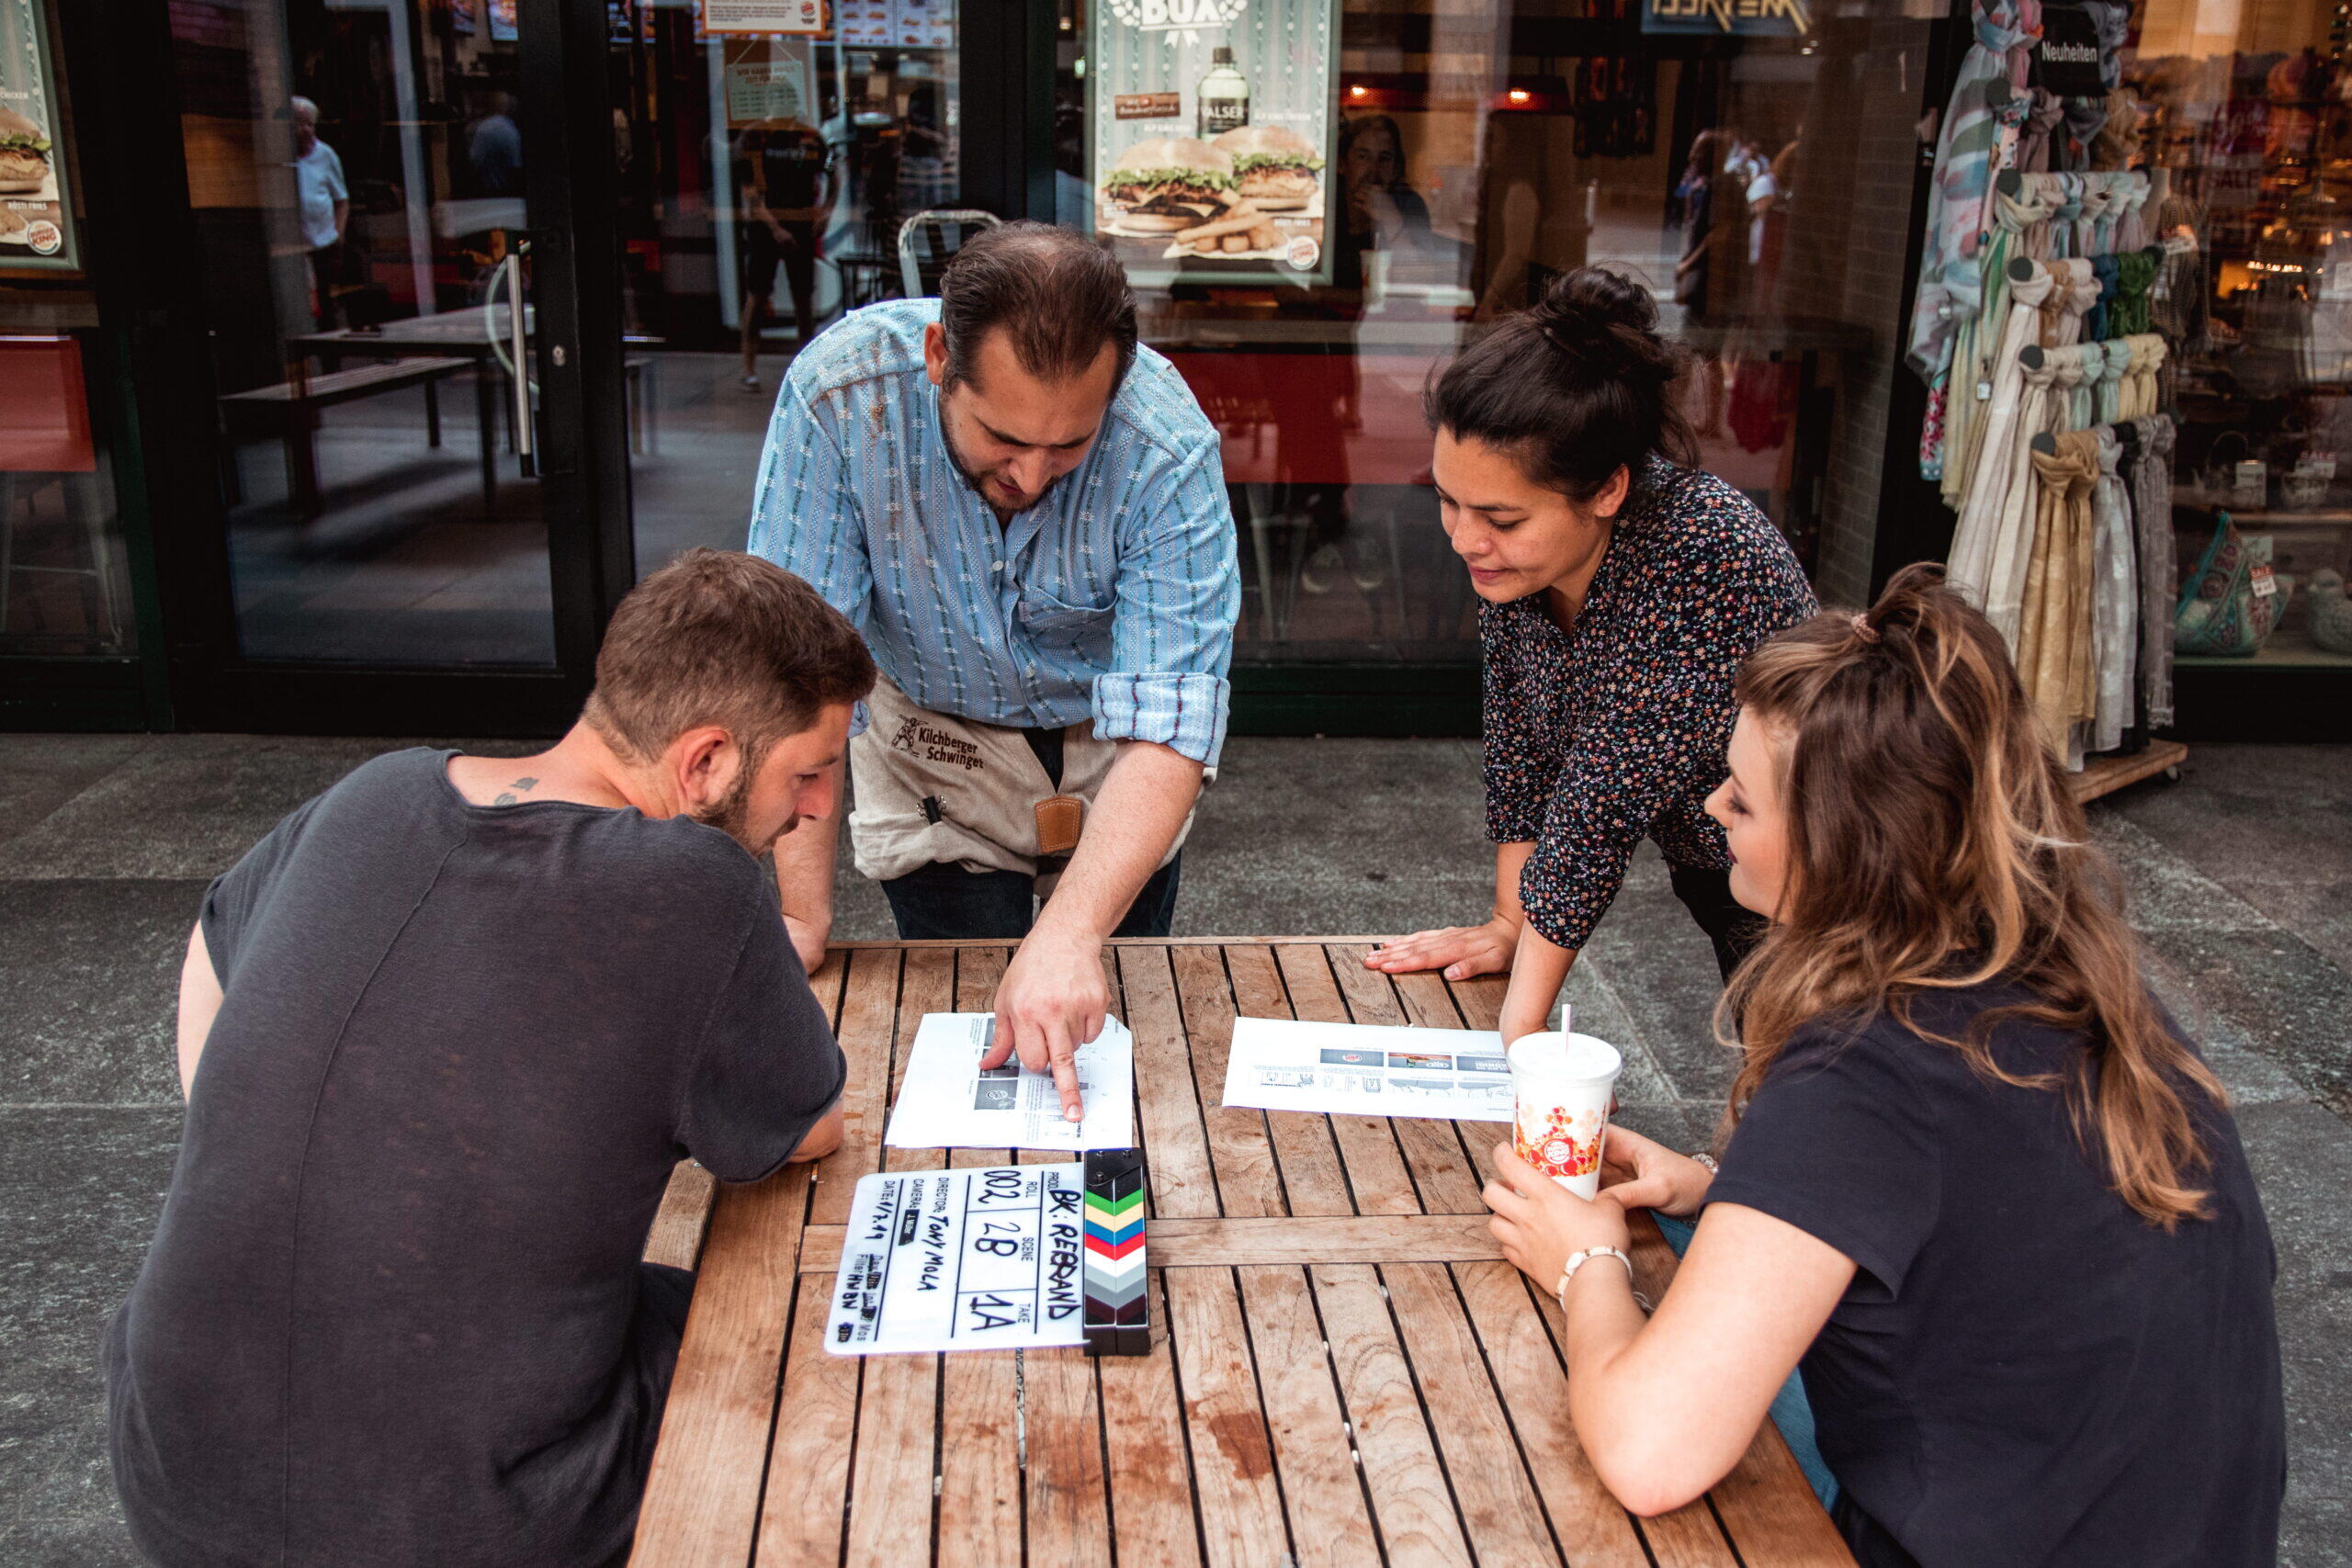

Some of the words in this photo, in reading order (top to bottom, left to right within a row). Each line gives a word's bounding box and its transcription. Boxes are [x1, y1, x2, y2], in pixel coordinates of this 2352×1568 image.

[2041, 40, 2098, 62] Neuheiten
[1201, 106, 1244, 119] VALSER
[918, 727, 978, 755] Kilchberger
[926, 746, 984, 770] Schwinget
[881, 1180, 896, 1200] DATE:
[978, 1170, 1022, 1204] 002
[1025, 1181, 1038, 1199] ROLL
[1046, 1171, 1060, 1190] PROD.
[910, 1179, 924, 1208] CAMERA:
[933, 1177, 949, 1213] DIRECTOR:
[974, 1222, 1022, 1257] 2B
[1021, 1237, 1034, 1261] SCENE
[854, 1254, 869, 1273] Filter
[1047, 1224, 1081, 1320] REBRAND
[969, 1293, 1017, 1331] 1A
[1017, 1303, 1032, 1324] TAKE
